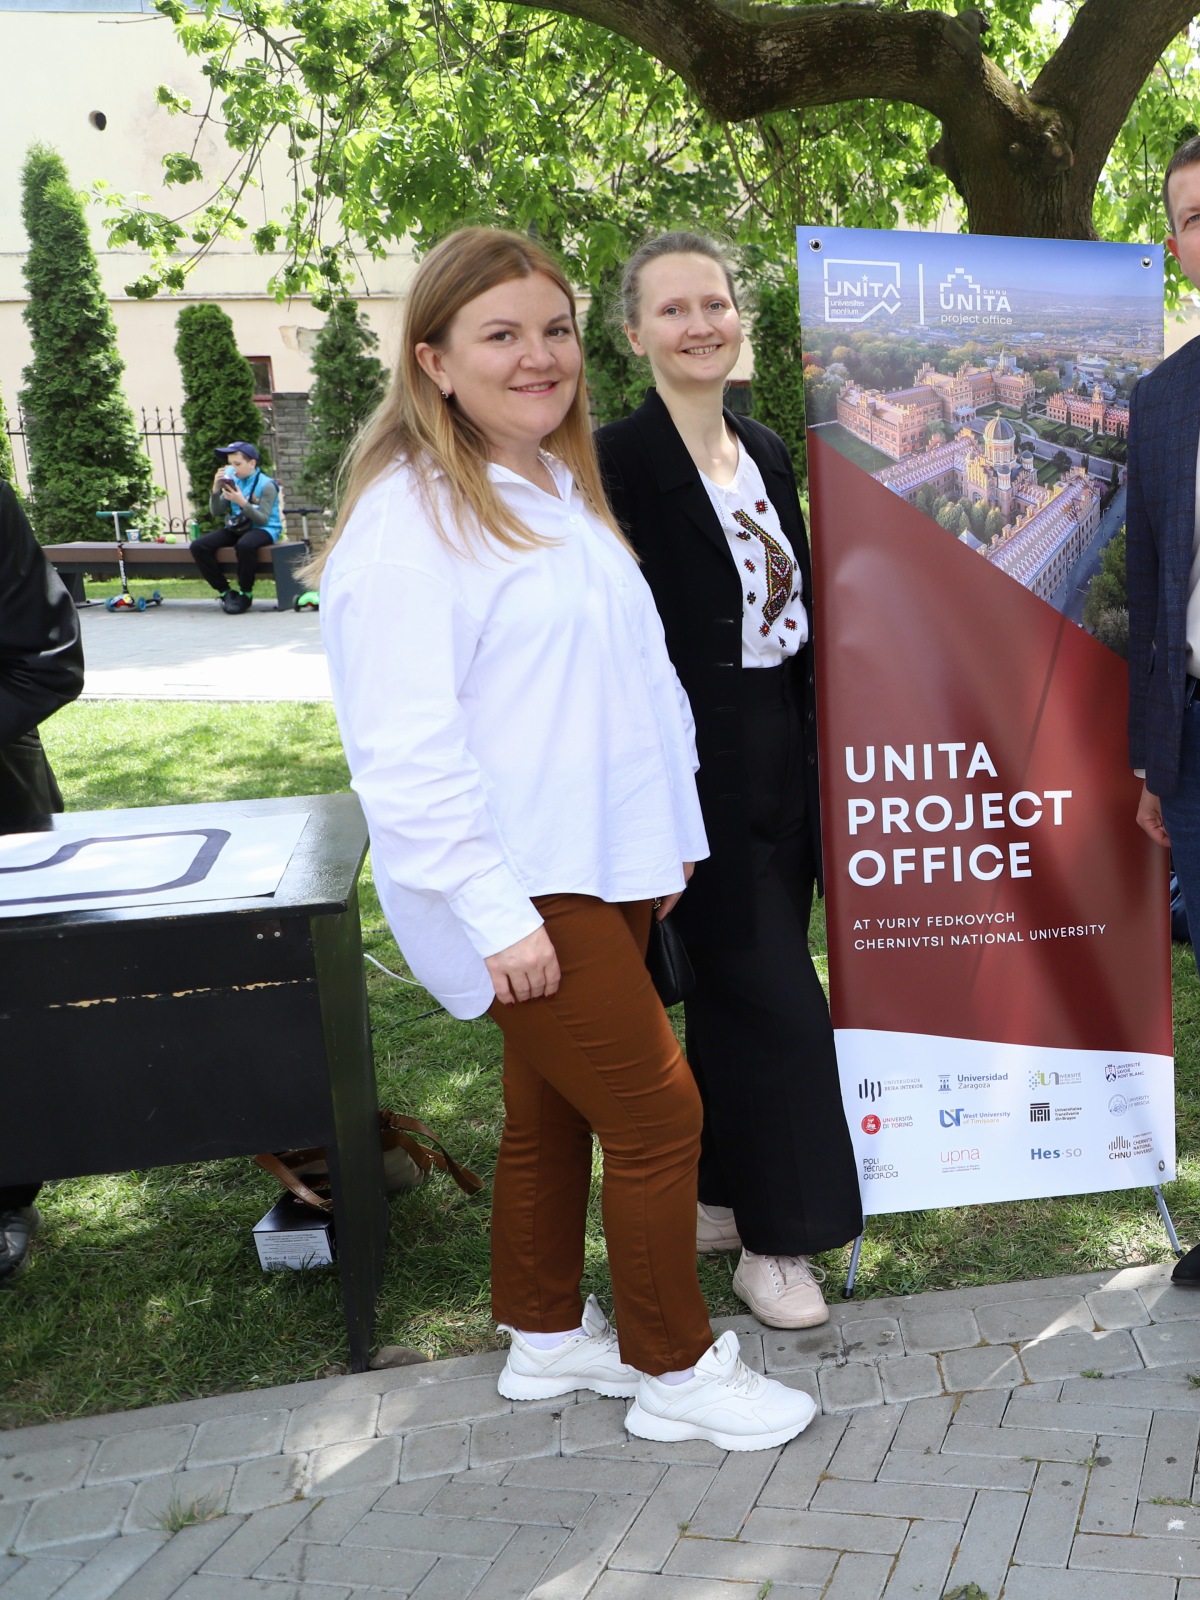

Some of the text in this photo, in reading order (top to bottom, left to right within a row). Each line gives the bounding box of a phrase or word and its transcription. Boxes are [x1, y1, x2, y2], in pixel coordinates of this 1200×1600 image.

[940, 293, 1012, 312] UNITA
[941, 313, 1013, 325] project office
[845, 741, 998, 783] UNITA
[847, 790, 1073, 835] PROJECT
[848, 841, 1032, 887] OFFICE
[853, 911, 1015, 930] AT YURIY FEDKOVYCH
[854, 924, 1107, 950] CHERNIVTSI NATIONAL UNIVERSITY
[957, 1073, 1008, 1082] Universidad
[958, 1082, 991, 1090] Zaragoza
[979, 1111, 1011, 1119] University
[891, 1121, 914, 1129] TORINO
[940, 1148, 980, 1165] upna
[1108, 1151, 1132, 1160] CHNU
